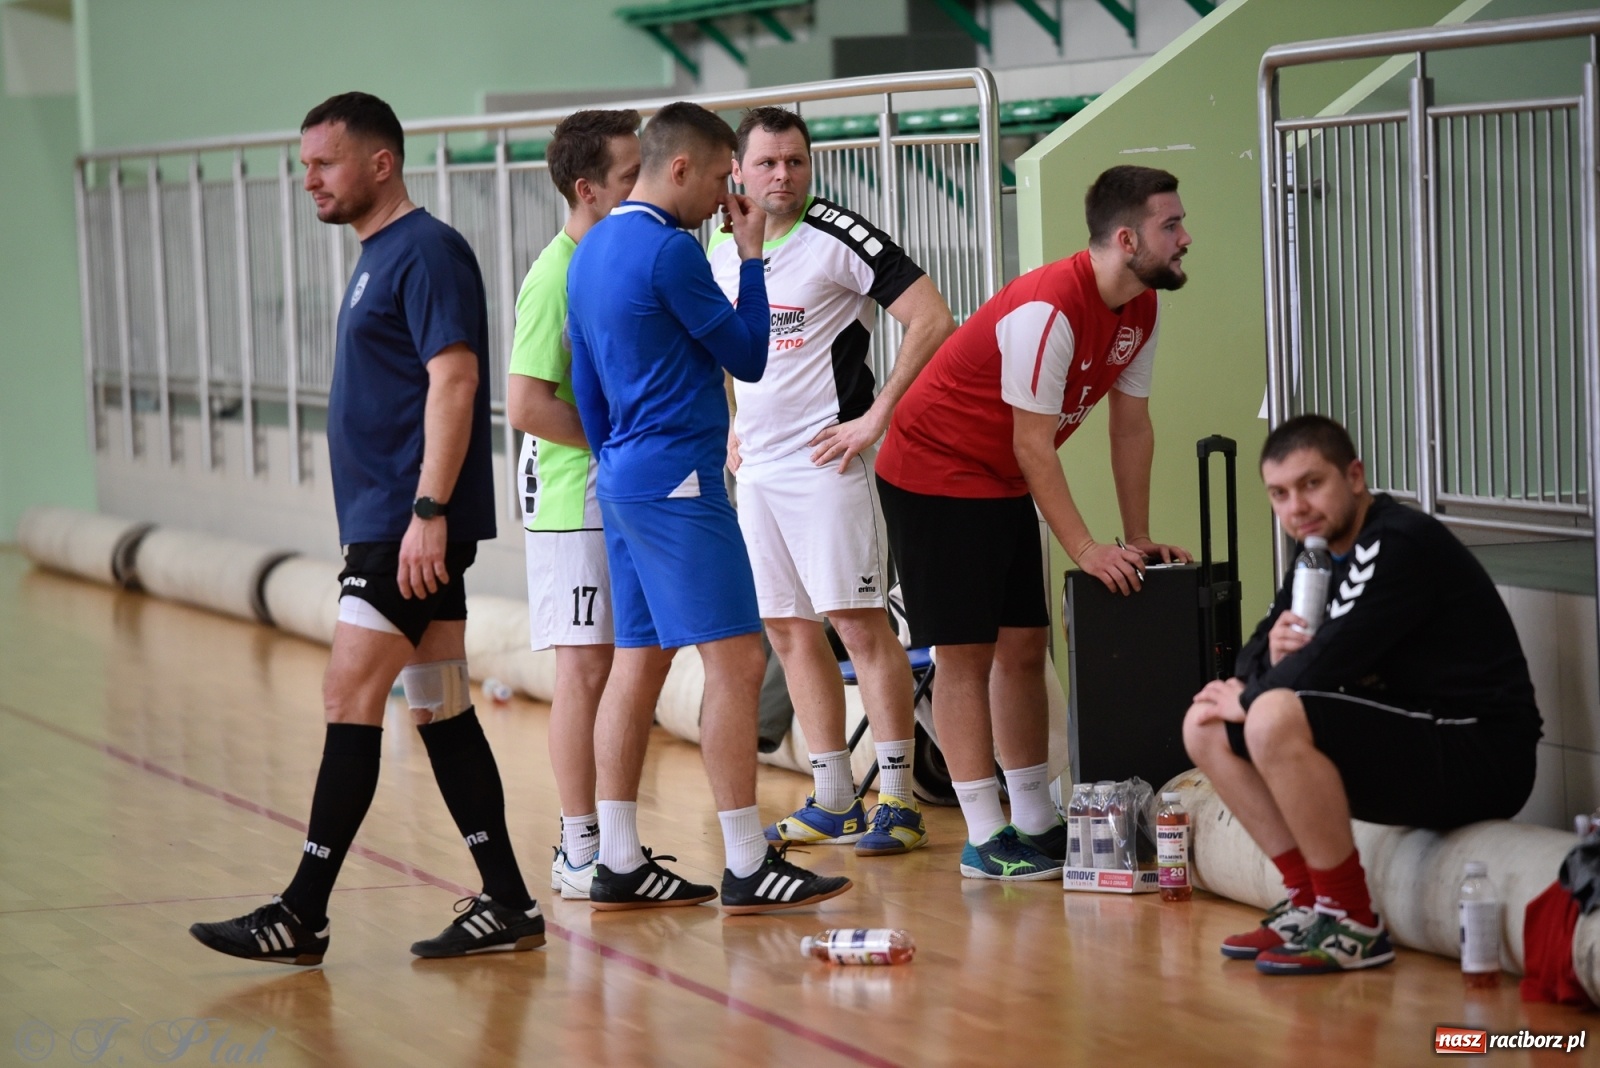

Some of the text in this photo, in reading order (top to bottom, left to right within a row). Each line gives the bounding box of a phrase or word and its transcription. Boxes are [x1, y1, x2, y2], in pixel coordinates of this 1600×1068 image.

[572, 586, 598, 626] 17
[842, 818, 858, 834] 5
[1170, 867, 1185, 877] 20
